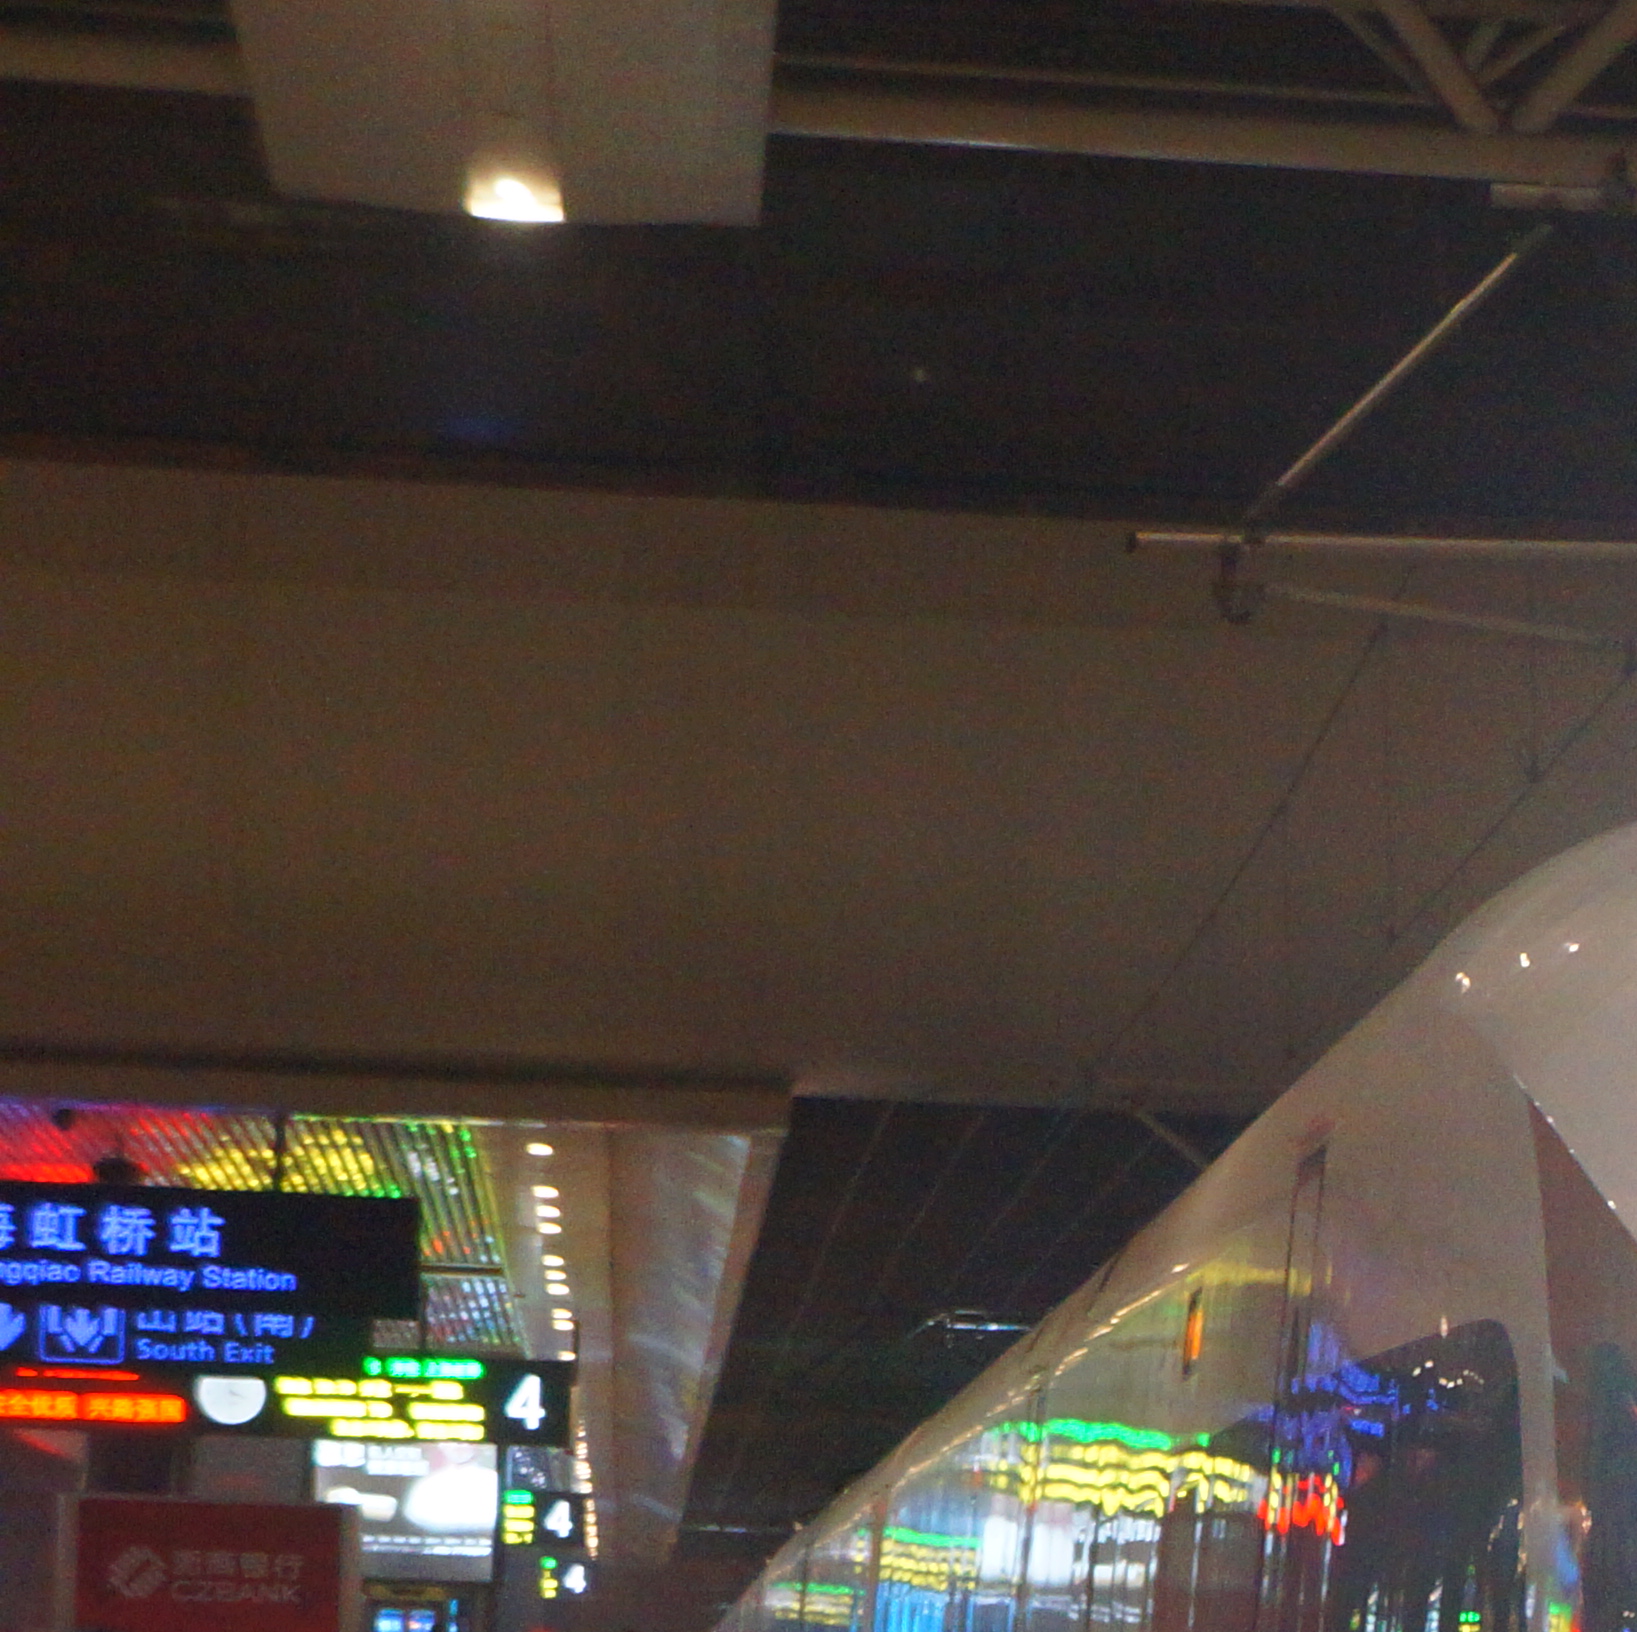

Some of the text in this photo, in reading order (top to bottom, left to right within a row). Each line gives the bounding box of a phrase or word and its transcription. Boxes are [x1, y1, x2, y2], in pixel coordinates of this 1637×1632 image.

[87, 1258, 196, 1292] Railway
[202, 1264, 297, 1291] Station
[136, 1337, 275, 1365] South Exit
[504, 1373, 546, 1430] 4
[544, 1500, 574, 1538] 4
[563, 1563, 587, 1594] 4
